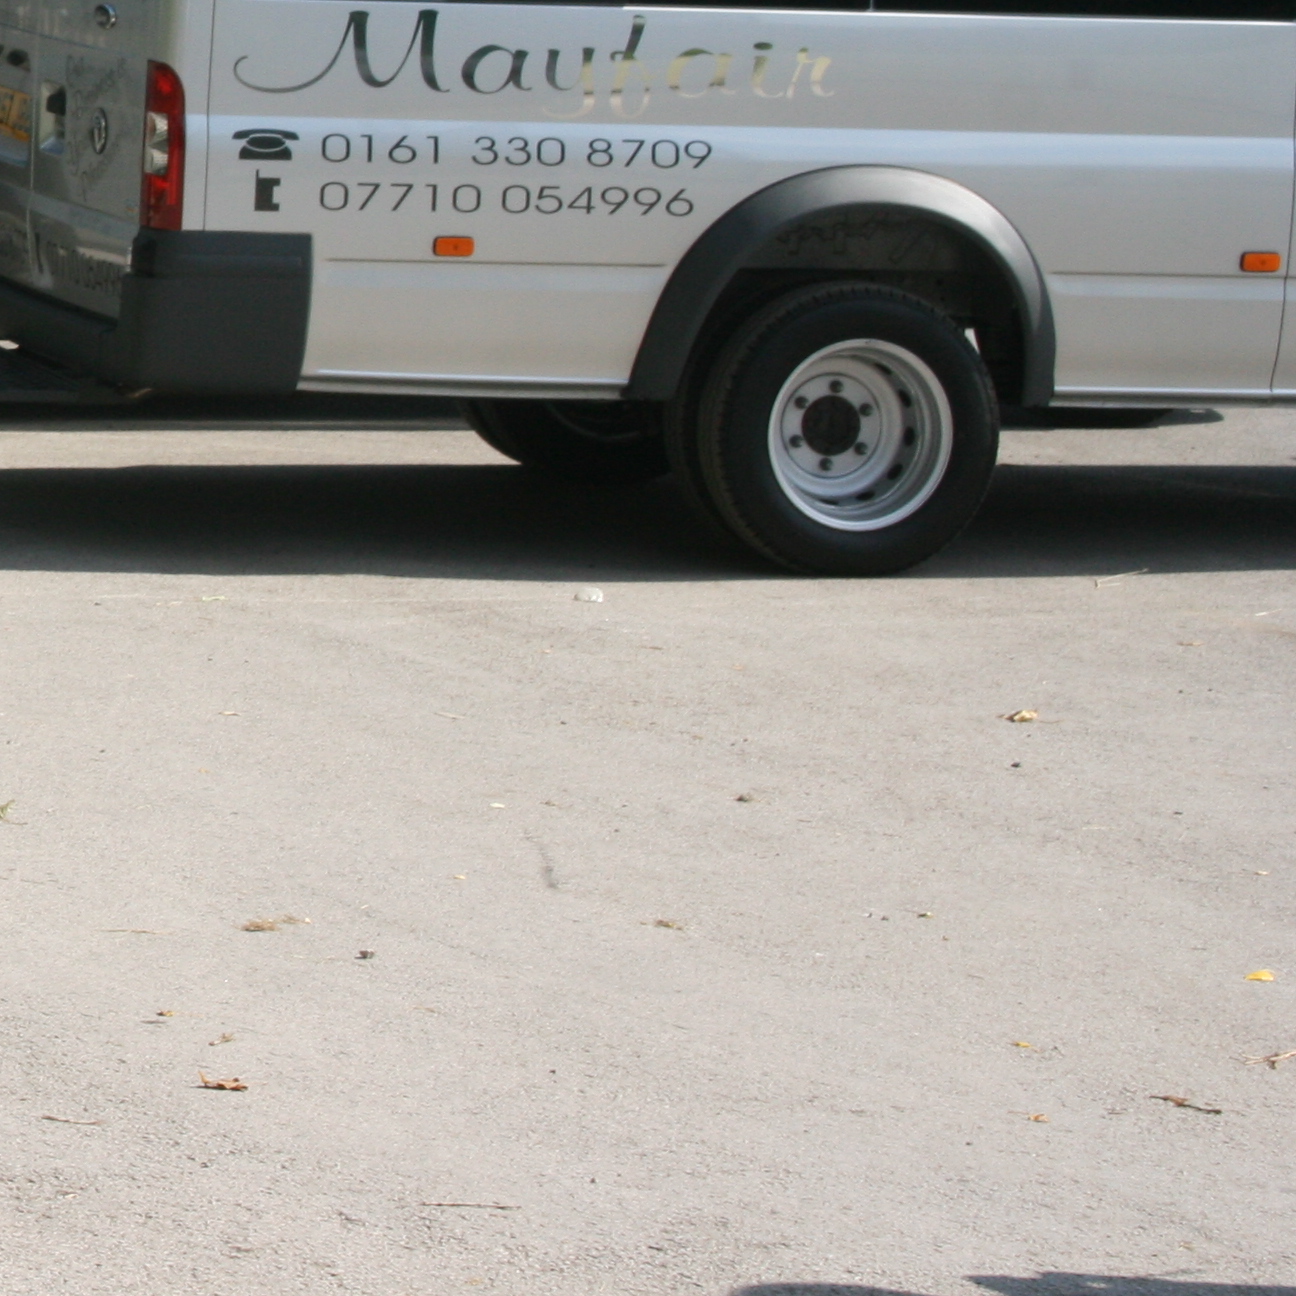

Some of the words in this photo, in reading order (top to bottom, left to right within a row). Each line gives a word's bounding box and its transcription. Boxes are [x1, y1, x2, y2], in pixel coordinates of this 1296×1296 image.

[233, 9, 836, 119] Mayfair
[321, 133, 441, 165] 0161
[471, 136, 566, 167] 330
[586, 139, 713, 170] 8709
[319, 181, 482, 214] 07710
[501, 185, 695, 217] 054996
